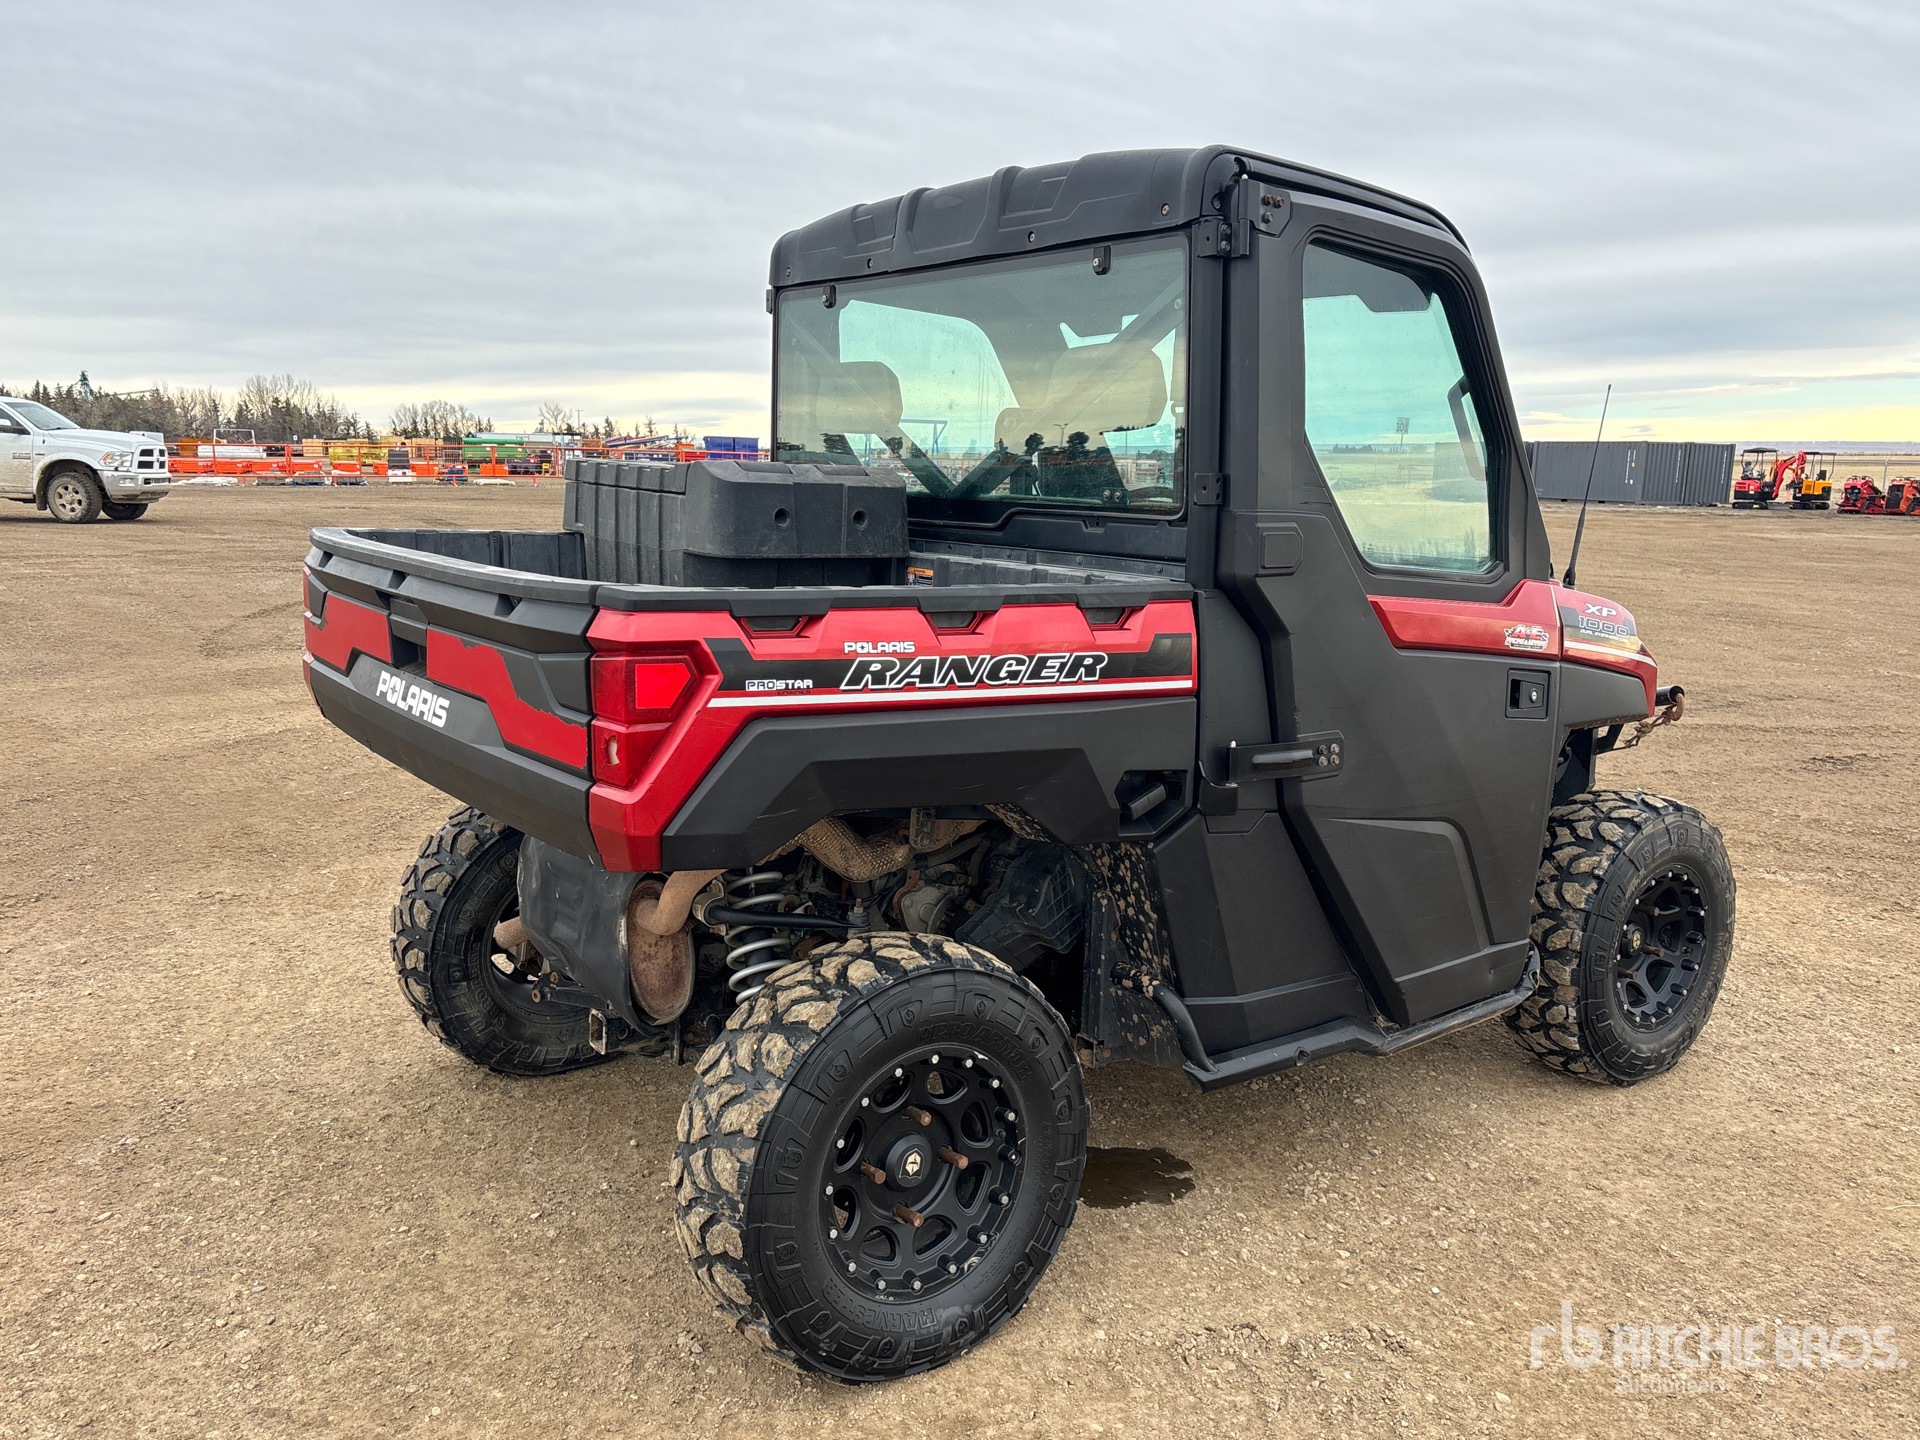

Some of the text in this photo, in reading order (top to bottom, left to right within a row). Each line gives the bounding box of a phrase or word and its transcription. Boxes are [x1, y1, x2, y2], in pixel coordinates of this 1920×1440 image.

[1584, 602, 1617, 617] XP
[1578, 615, 1630, 638] 1000
[843, 641, 915, 653] POLARIS
[840, 651, 1109, 690] RANGER
[376, 670, 450, 728] POLARIS
[822, 1277, 938, 1333] HARVESTER
